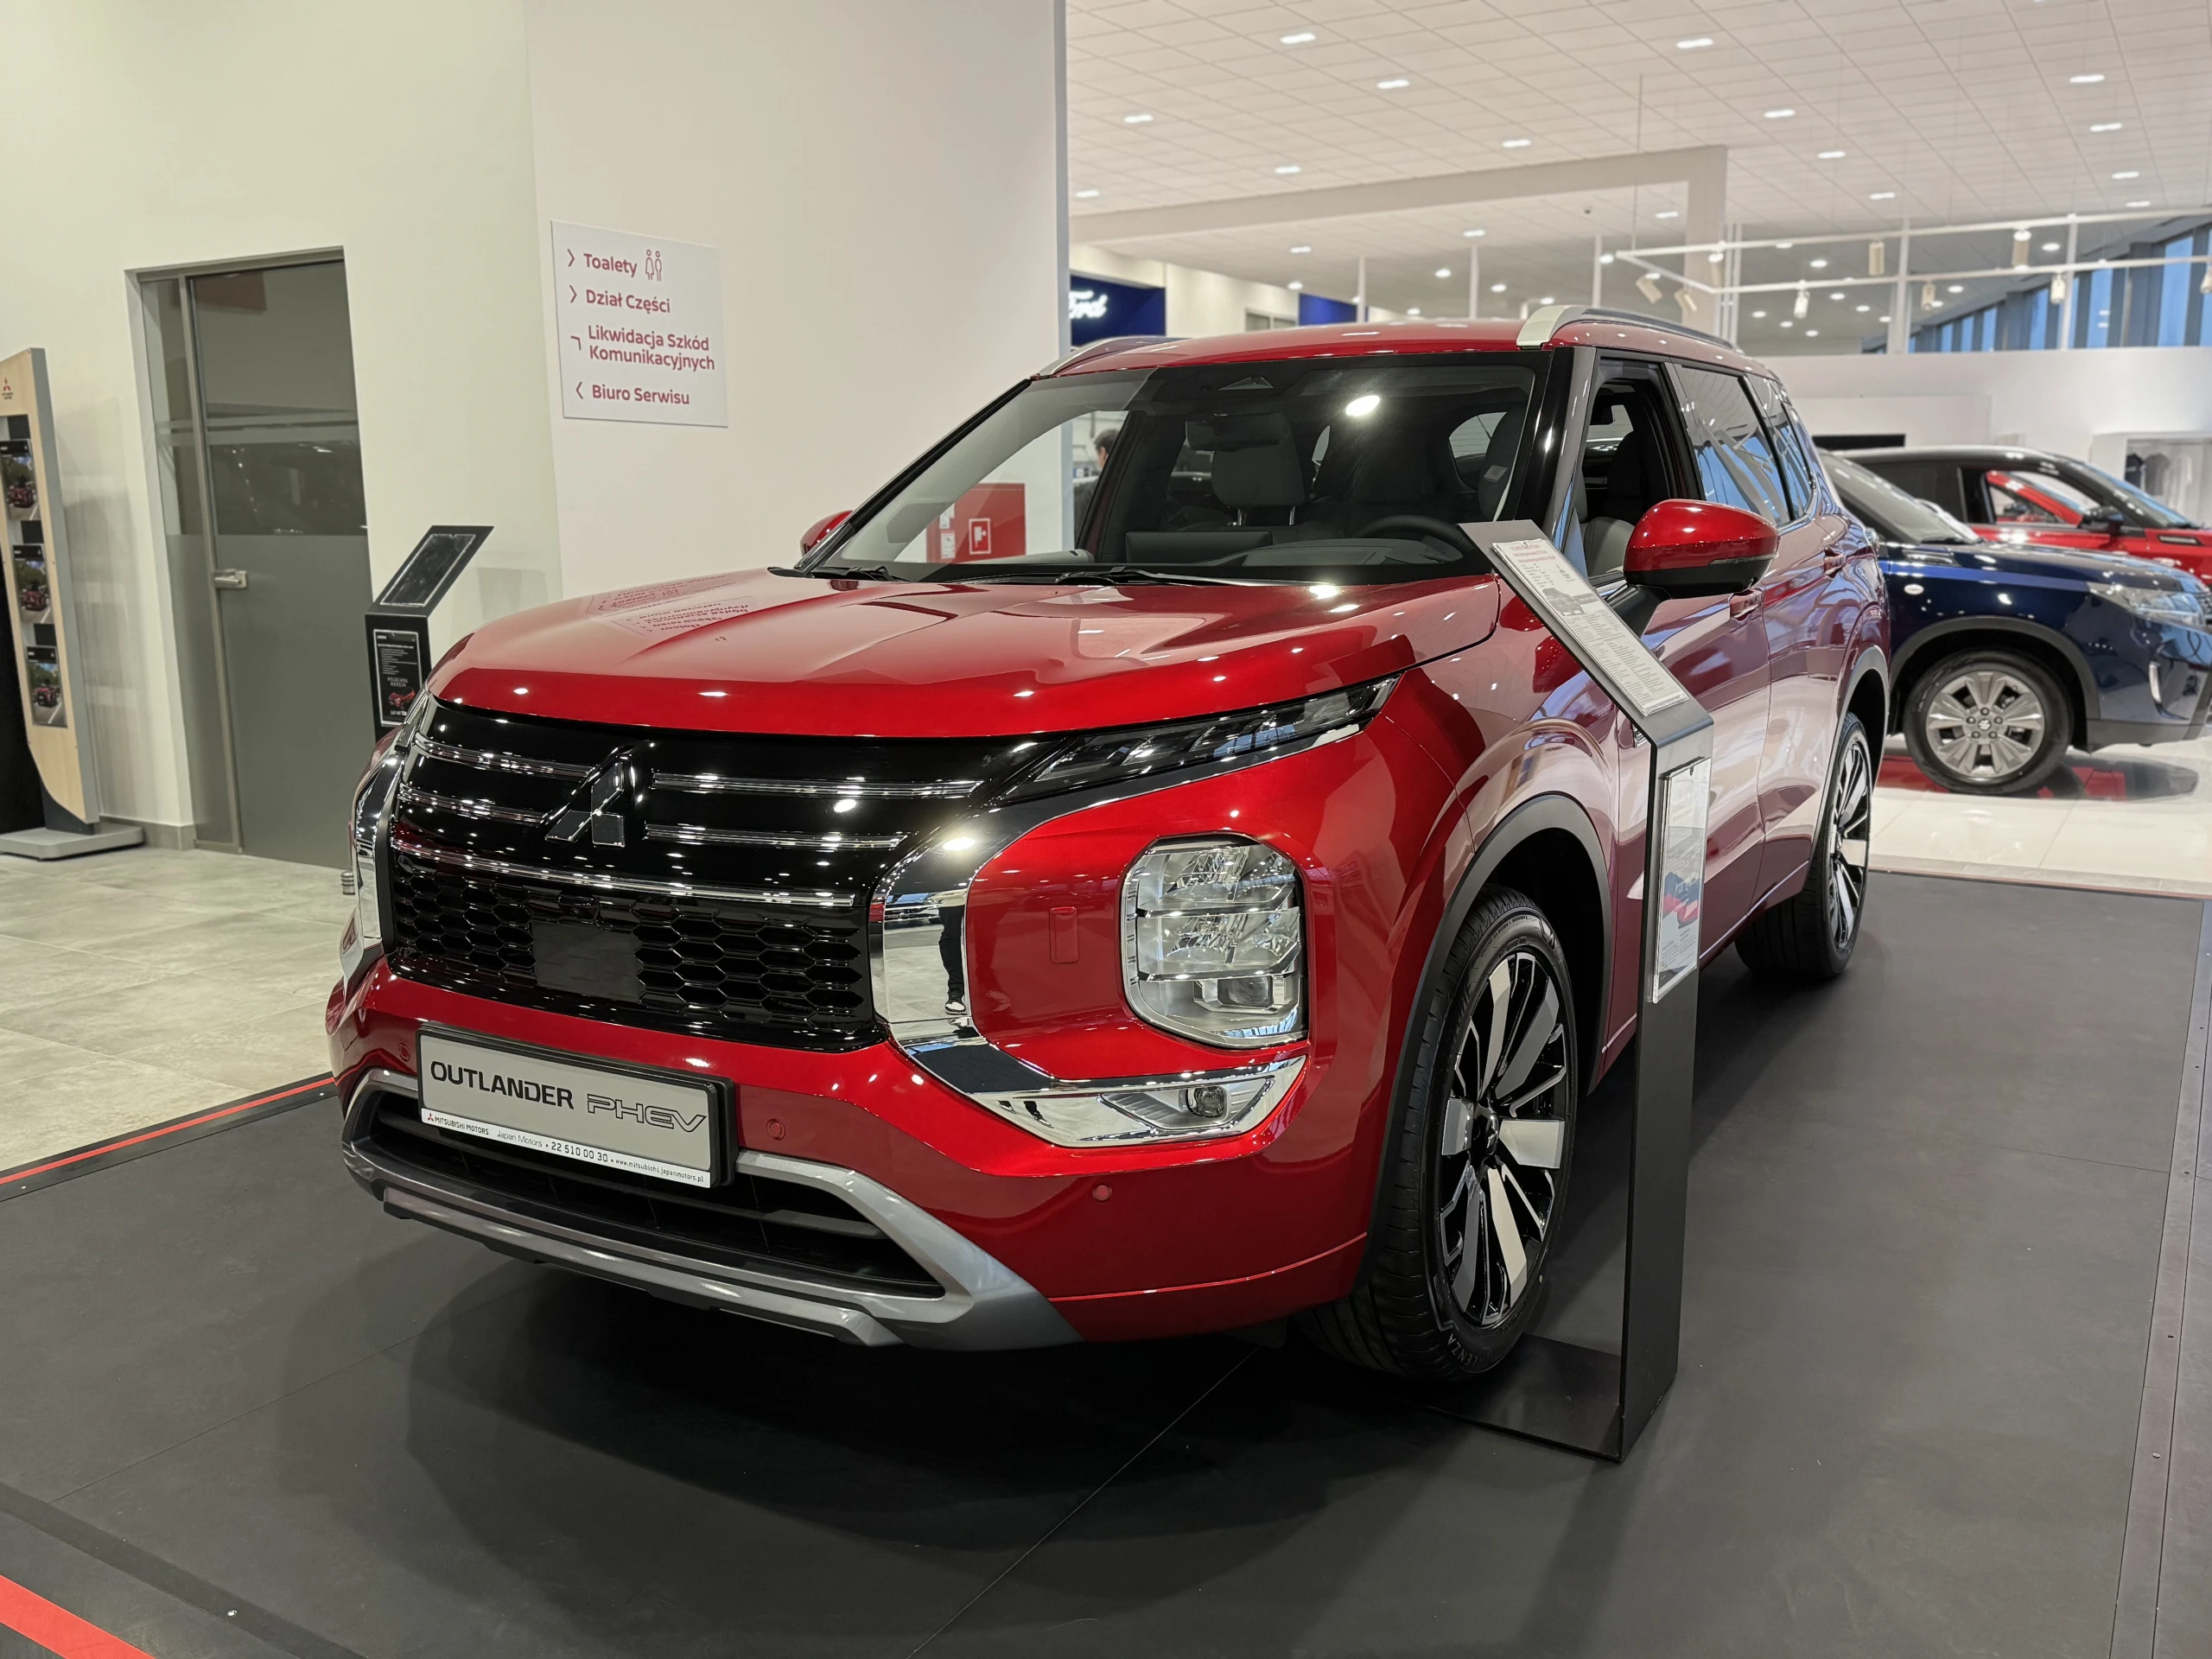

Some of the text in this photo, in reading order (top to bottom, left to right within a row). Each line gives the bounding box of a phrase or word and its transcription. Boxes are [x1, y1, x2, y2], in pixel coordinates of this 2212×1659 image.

[583, 252, 638, 277] Toalety
[586, 289, 671, 314] Dział Części
[588, 325, 709, 351] Likwidacja Szkód
[589, 345, 715, 372] Komunikacyjnych
[592, 384, 690, 404] Biuro Serwisu
[430, 1060, 707, 1133] OUTLANDER PHEV
[435, 1116, 465, 1130] MITSUBISHI
[466, 1123, 489, 1135] MOTORS
[497, 1129, 517, 1141] Japan
[518, 1135, 543, 1147] Motors
[551, 1141, 562, 1152] 22
[564, 1144, 581, 1156] 510
[583, 1148, 594, 1160] 00
[597, 1152, 608, 1163] 30
